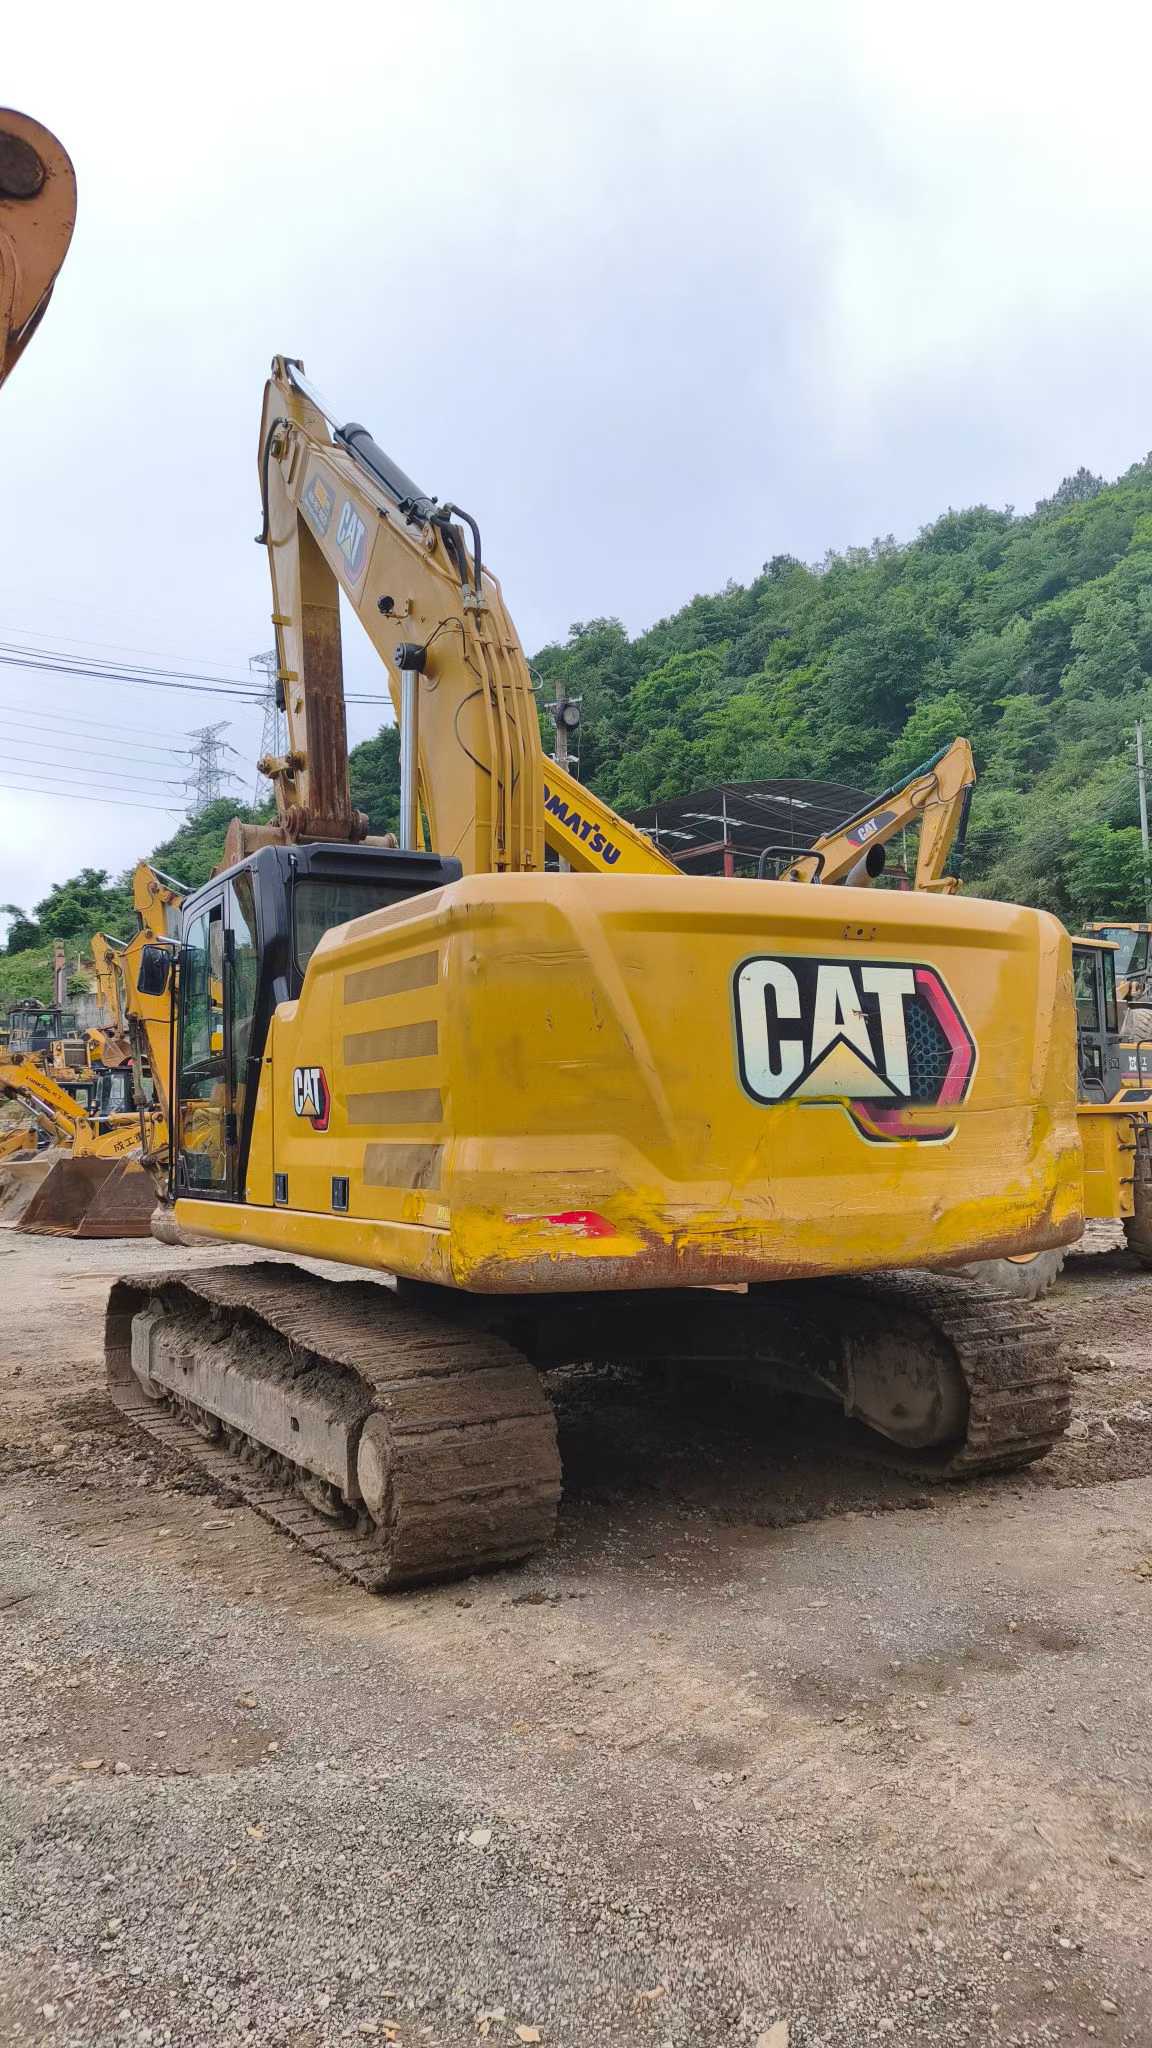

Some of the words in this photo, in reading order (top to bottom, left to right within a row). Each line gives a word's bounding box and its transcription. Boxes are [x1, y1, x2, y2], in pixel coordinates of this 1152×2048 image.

[336, 501, 365, 567] CAT
[858, 818, 878, 841] CAT
[738, 960, 916, 1098] CAT
[294, 1069, 320, 1114] CAT
